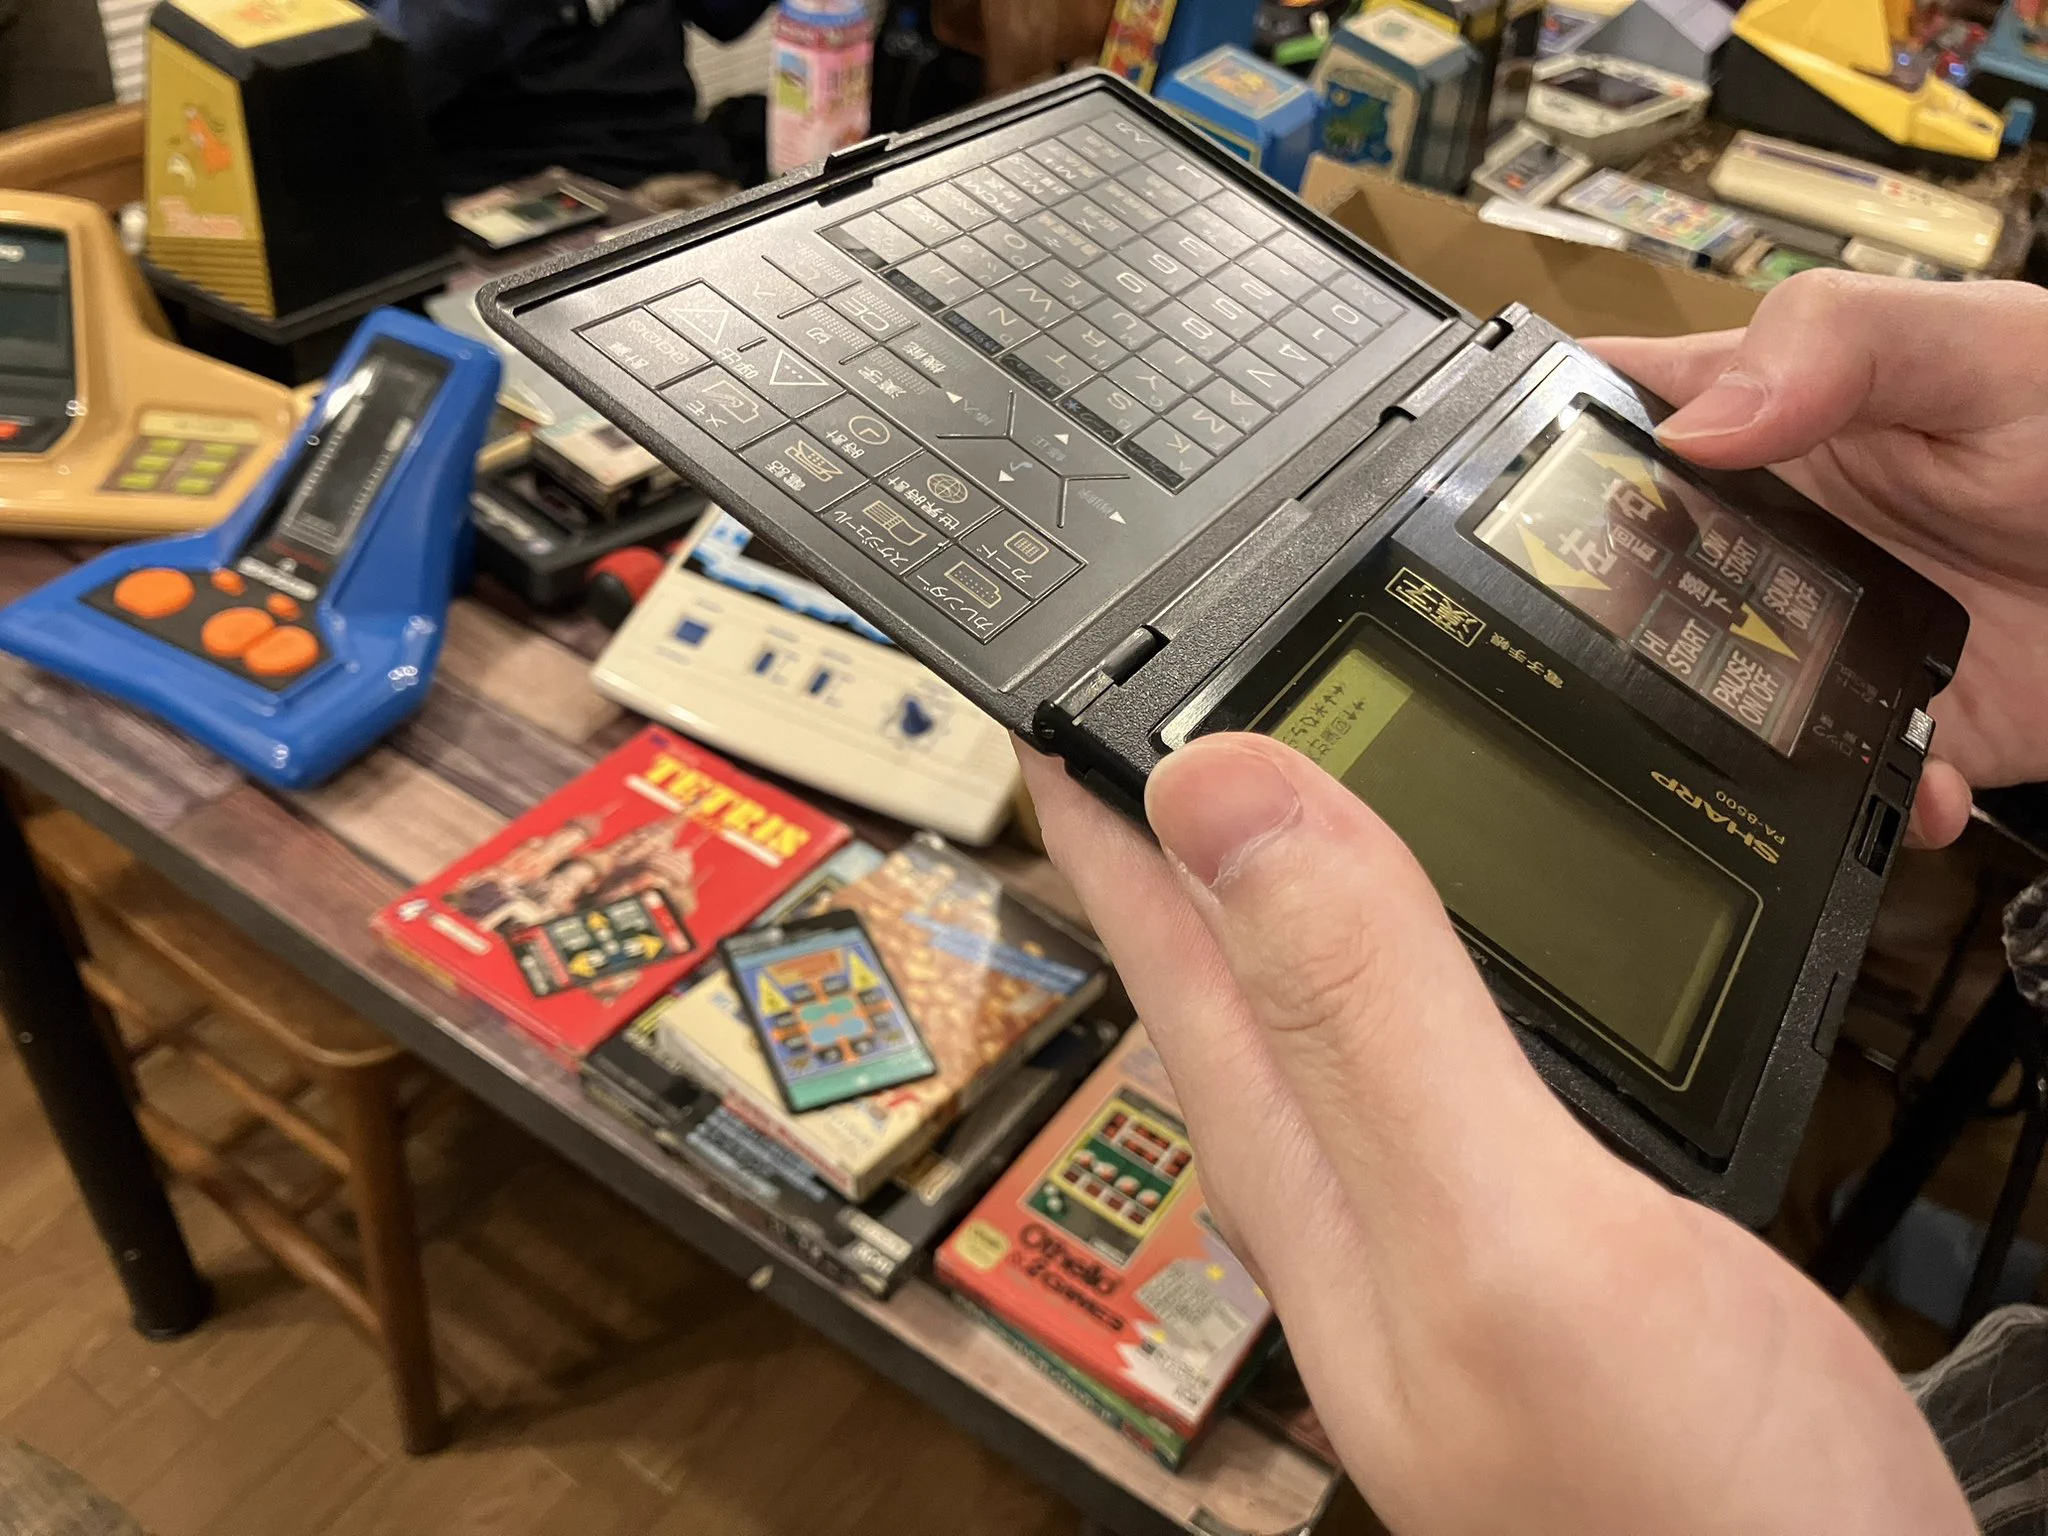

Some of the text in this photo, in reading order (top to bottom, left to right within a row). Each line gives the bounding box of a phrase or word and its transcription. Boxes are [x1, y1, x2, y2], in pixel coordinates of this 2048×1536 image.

[1115, 122, 1151, 143] 入力
[1178, 236, 1211, 257] 3
[929, 265, 959, 284] H
[1147, 253, 1177, 274] 6
[1056, 272, 1081, 288] E
[1115, 272, 1147, 293] 9
[1240, 279, 1272, 300] 2
[839, 296, 889, 331] CE
[1015, 287, 1052, 312] W
[1210, 297, 1244, 320] 5
[987, 306, 1017, 326] N
[1111, 312, 1137, 329] U
[1181, 316, 1213, 339] 8
[805, 327, 833, 344] 切
[1081, 329, 1106, 347] R
[1312, 327, 1324, 340] 1
[715, 344, 758, 379] 呼出
[901, 341, 946, 373] 機能
[1045, 354, 1067, 368] T
[1278, 343, 1307, 361] 4
[857, 365, 906, 398] 漢字
[1135, 375, 1157, 390] Y
[1246, 369, 1276, 387] 7
[1106, 391, 1131, 409] S
[1229, 389, 1253, 405] A
[685, 399, 727, 427] メモ
[1191, 408, 1227, 433] M
[825, 429, 864, 458] 時計
[1165, 433, 1191, 453] K
[764, 459, 805, 490] 電話
[887, 476, 959, 530] 世界時計
[1600, 477, 1655, 520] 右
[834, 510, 908, 567] スケジュール
[1558, 527, 1617, 574] 左
[1607, 524, 1657, 561] 回転
[1695, 529, 1729, 568] LOW
[976, 544, 1032, 582] カード
[1719, 536, 1758, 584] START
[916, 574, 993, 630] カレンダー
[1678, 571, 1733, 614] 落下
[1762, 566, 1800, 614] SOUND
[1396, 578, 1479, 642] 漢字
[1638, 629, 1668, 656] HI
[1666, 618, 1710, 674] START
[1490, 632, 1563, 689] 電子手帳
[1712, 650, 1756, 708] PAUSE
[645, 752, 811, 859] TETRIS
[1651, 771, 1779, 864] SHARP
[1716, 790, 1785, 845] PA-8500
